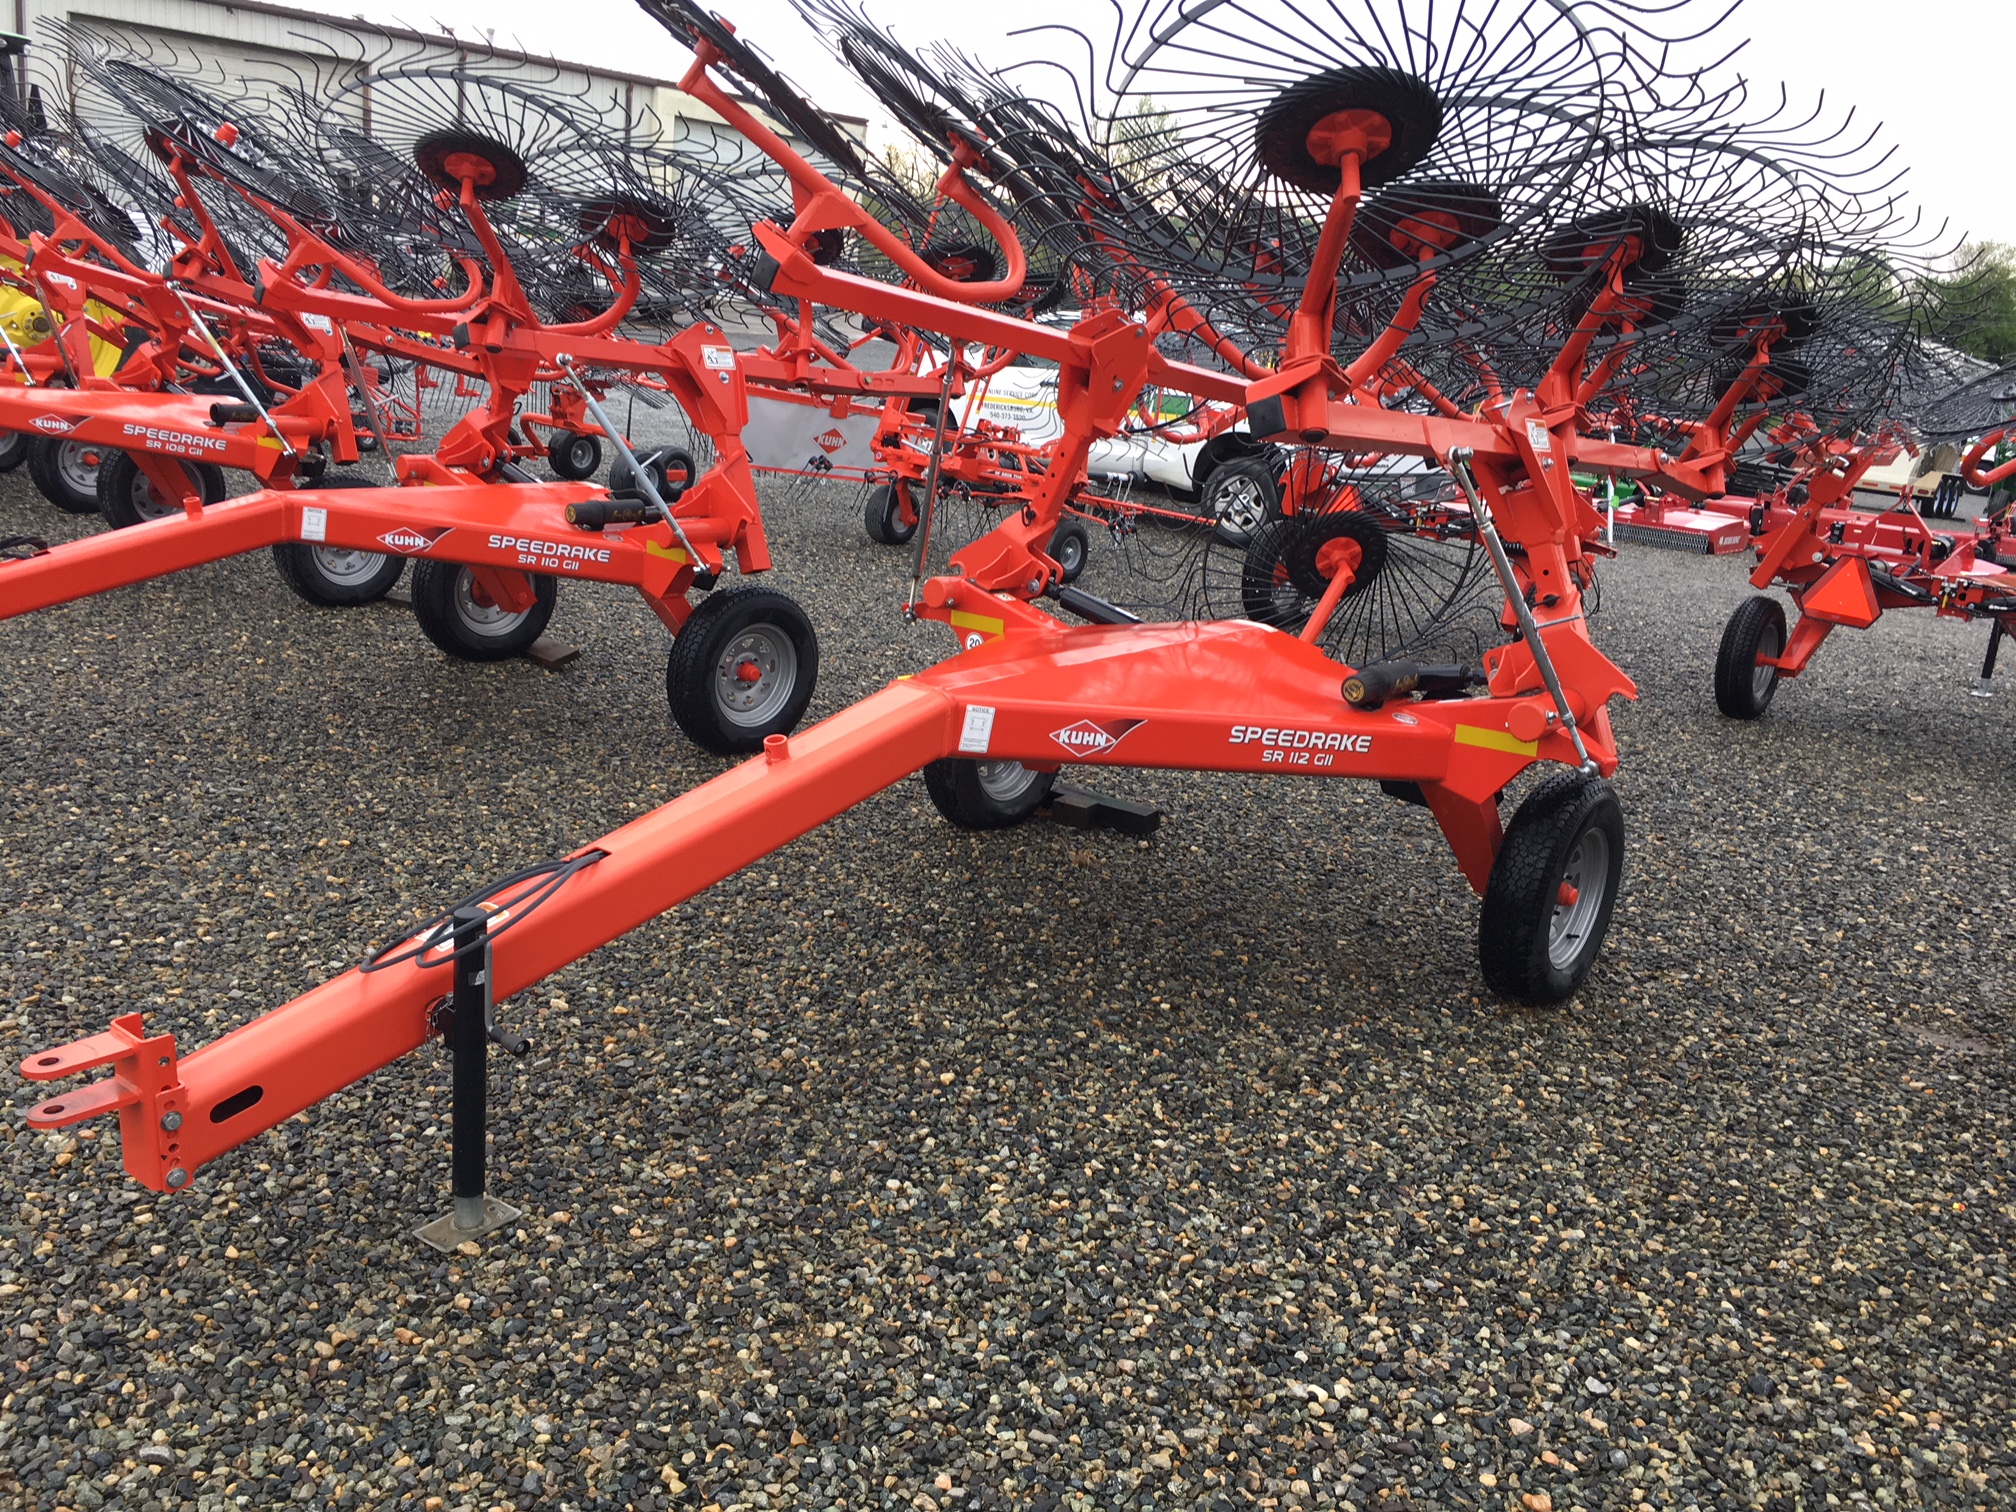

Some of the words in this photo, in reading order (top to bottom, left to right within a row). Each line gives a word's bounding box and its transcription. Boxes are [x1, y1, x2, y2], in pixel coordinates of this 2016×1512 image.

[35, 418, 68, 430] KUHN
[123, 424, 227, 451] SPEEDRAKE
[818, 434, 845, 447] KUHN
[145, 439, 162, 449] SR
[165, 443, 185, 453] 108
[188, 446, 203, 456] GII
[384, 533, 425, 547] KUHN
[488, 534, 611, 562] SPEEDRAKE
[518, 554, 537, 565] SR
[541, 557, 559, 568] 110
[562, 560, 579, 570] GII
[969, 637, 980, 648] 20
[1058, 730, 1108, 747] KUHN
[1228, 725, 1372, 753] SPEEDRAKE
[1261, 750, 1284, 763] SR
[1288, 751, 1310, 764] 112
[1313, 754, 1334, 766] GII
